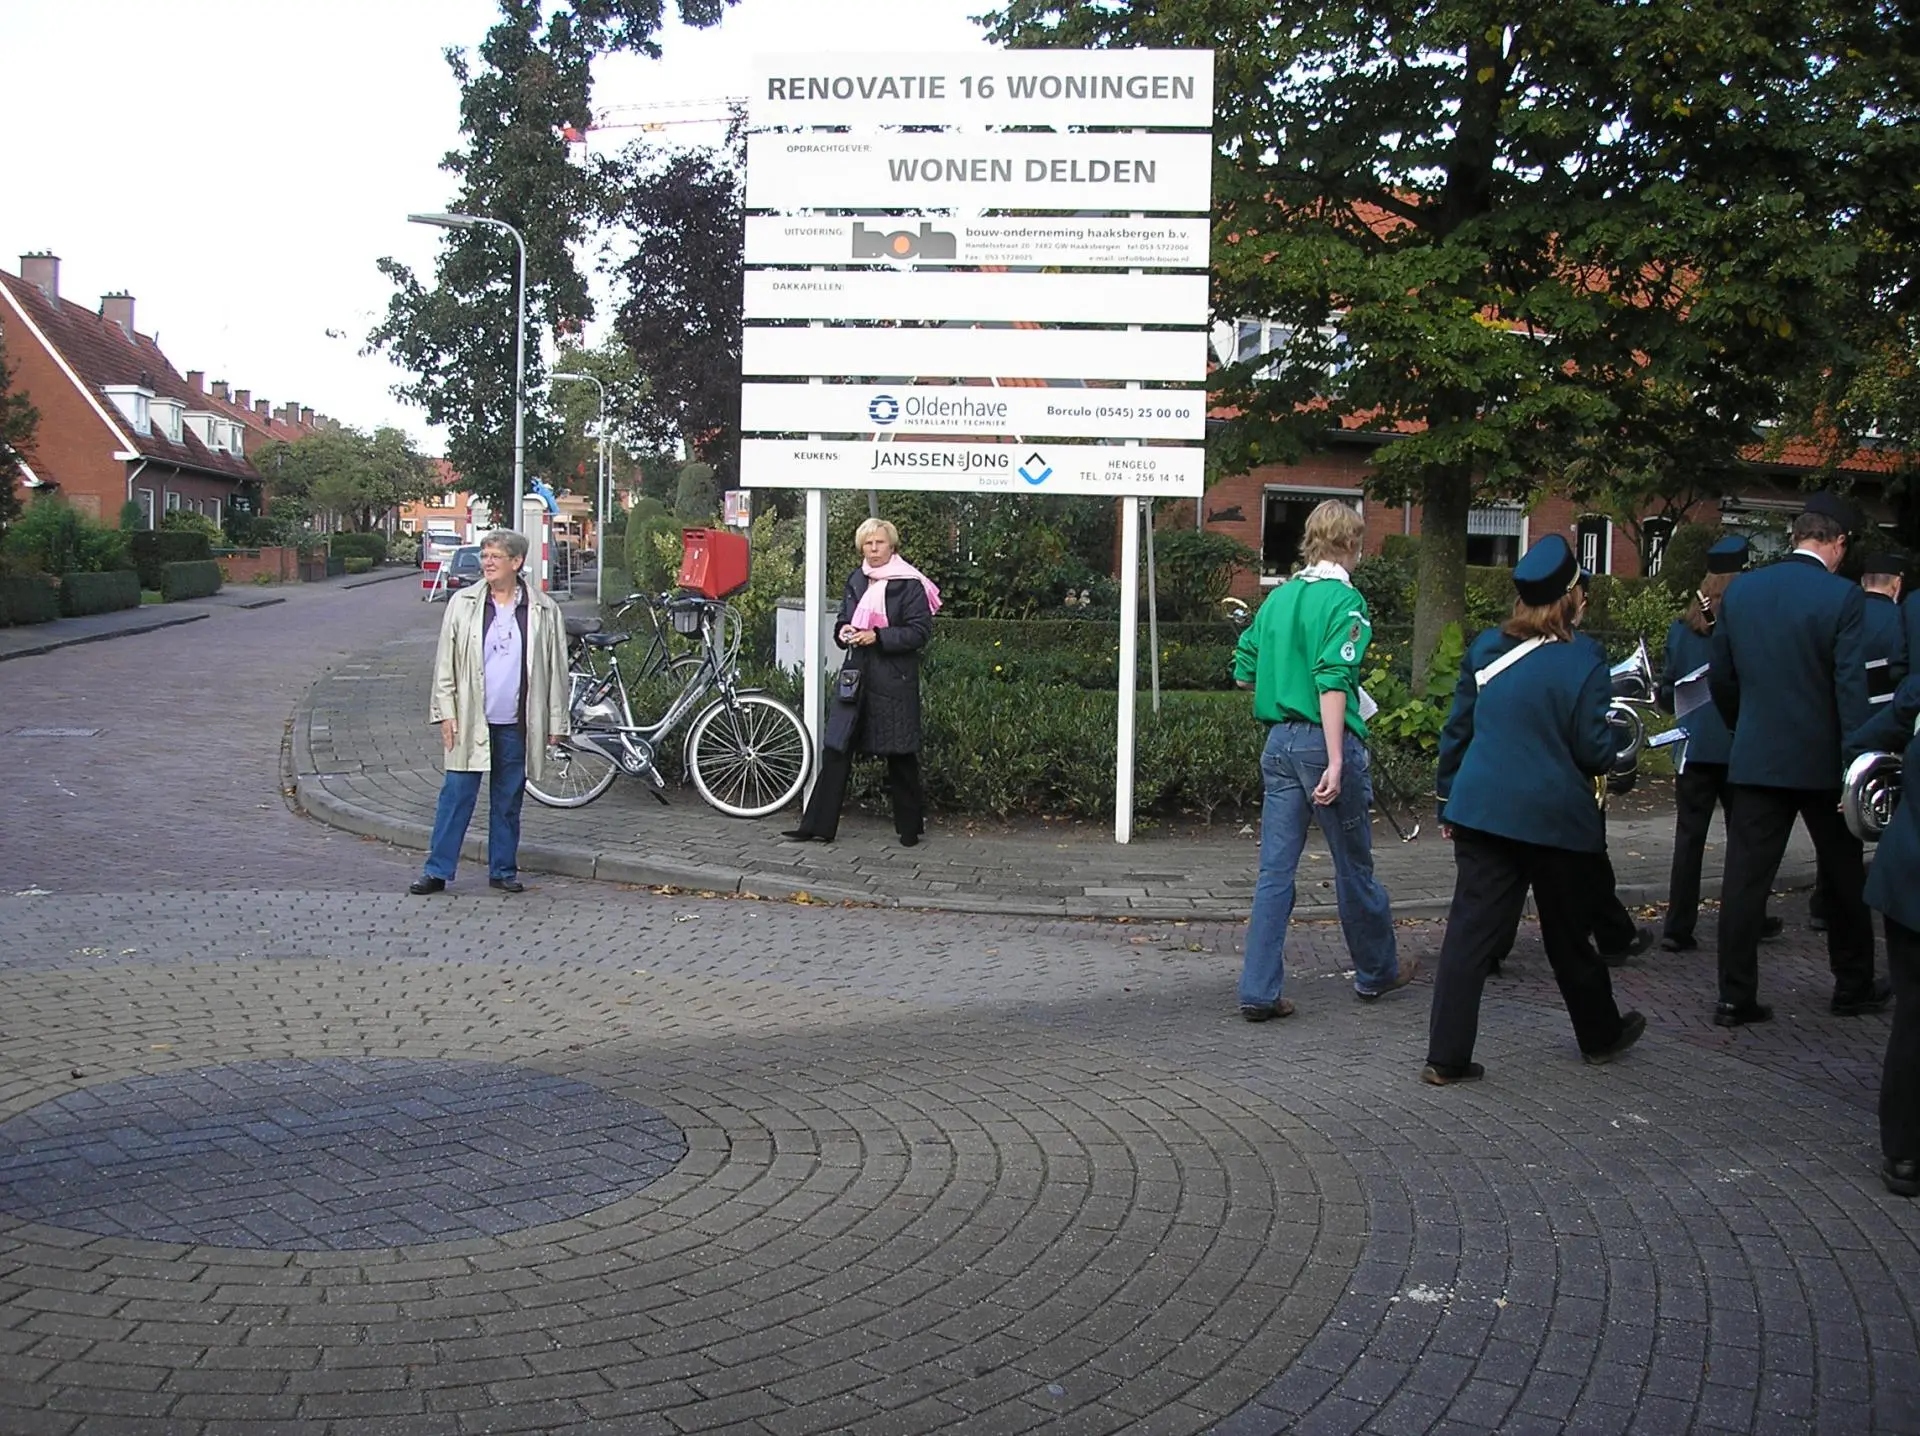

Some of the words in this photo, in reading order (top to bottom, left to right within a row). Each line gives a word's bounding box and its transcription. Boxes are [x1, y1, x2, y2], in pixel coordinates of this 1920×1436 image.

[768, 76, 945, 100] RENOVATIE
[959, 76, 995, 99] 16
[1006, 75, 1194, 99] WONINGEN
[786, 144, 873, 153] OPDRACHTGEVER:
[888, 158, 1013, 182] WONEN
[1025, 159, 1156, 184] DELDEN
[1087, 228, 1165, 241] haaksbergen
[1168, 229, 1190, 239] b.v.
[772, 282, 845, 291] DAKKAPELLEN:
[905, 396, 1008, 417] Oldenhave
[1046, 406, 1092, 417] Borculo
[1095, 407, 1134, 419] (0545)
[1137, 408, 1153, 418] 25
[1156, 408, 1172, 419] 00
[1174, 409, 1190, 419] 00
[904, 418, 959, 426] INSTALLATIE
[963, 419, 1007, 427] TECHNIEK
[793, 451, 841, 461] KEUKENS:
[871, 449, 955, 470] JANSSEN
[962, 451, 1009, 472] JONG
[1108, 460, 1157, 470] HENGELO
[979, 477, 1009, 486] bouw
[1104, 472, 1123, 481] 074
[1135, 473, 1155, 482] 256
[1159, 473, 1170, 482] 14
[1174, 474, 1185, 482] 14
